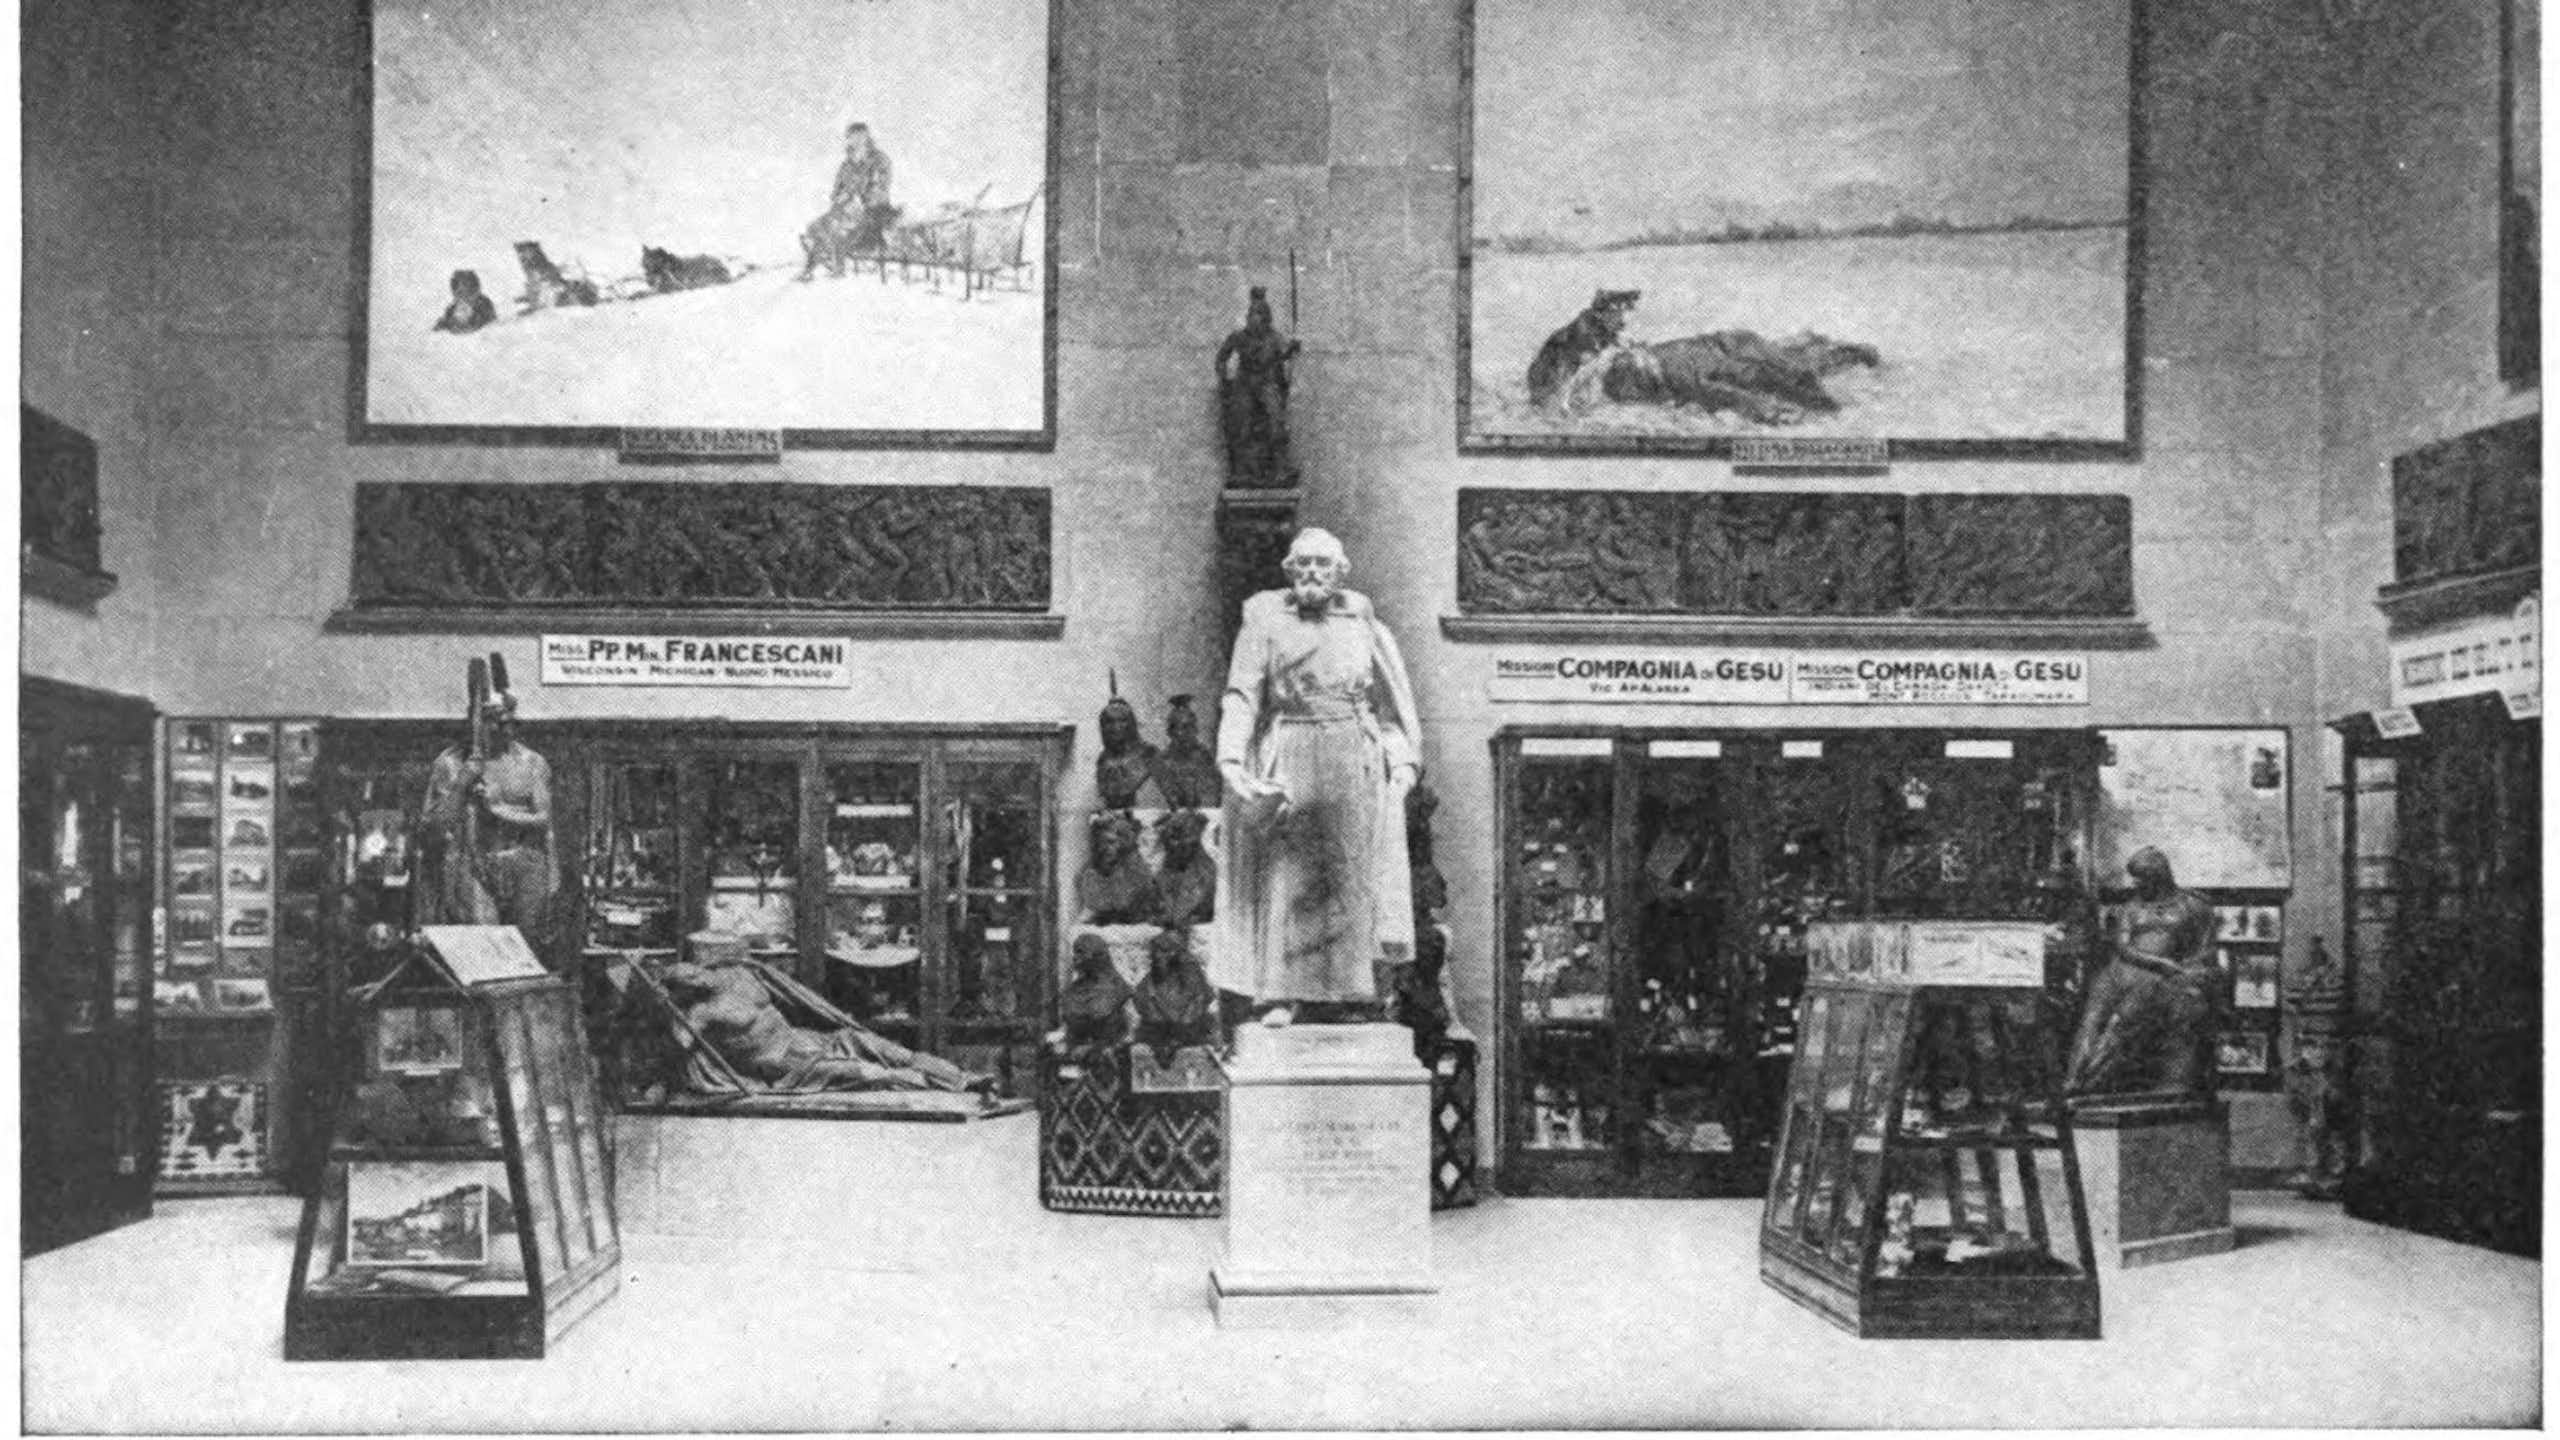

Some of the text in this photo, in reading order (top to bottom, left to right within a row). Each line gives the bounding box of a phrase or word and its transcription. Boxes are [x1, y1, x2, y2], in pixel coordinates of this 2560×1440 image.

[665, 639, 843, 664] FRANCESCANI
[1558, 657, 1697, 679] COMPAGNIA
[1857, 659, 1997, 681] COMPAGNIA
